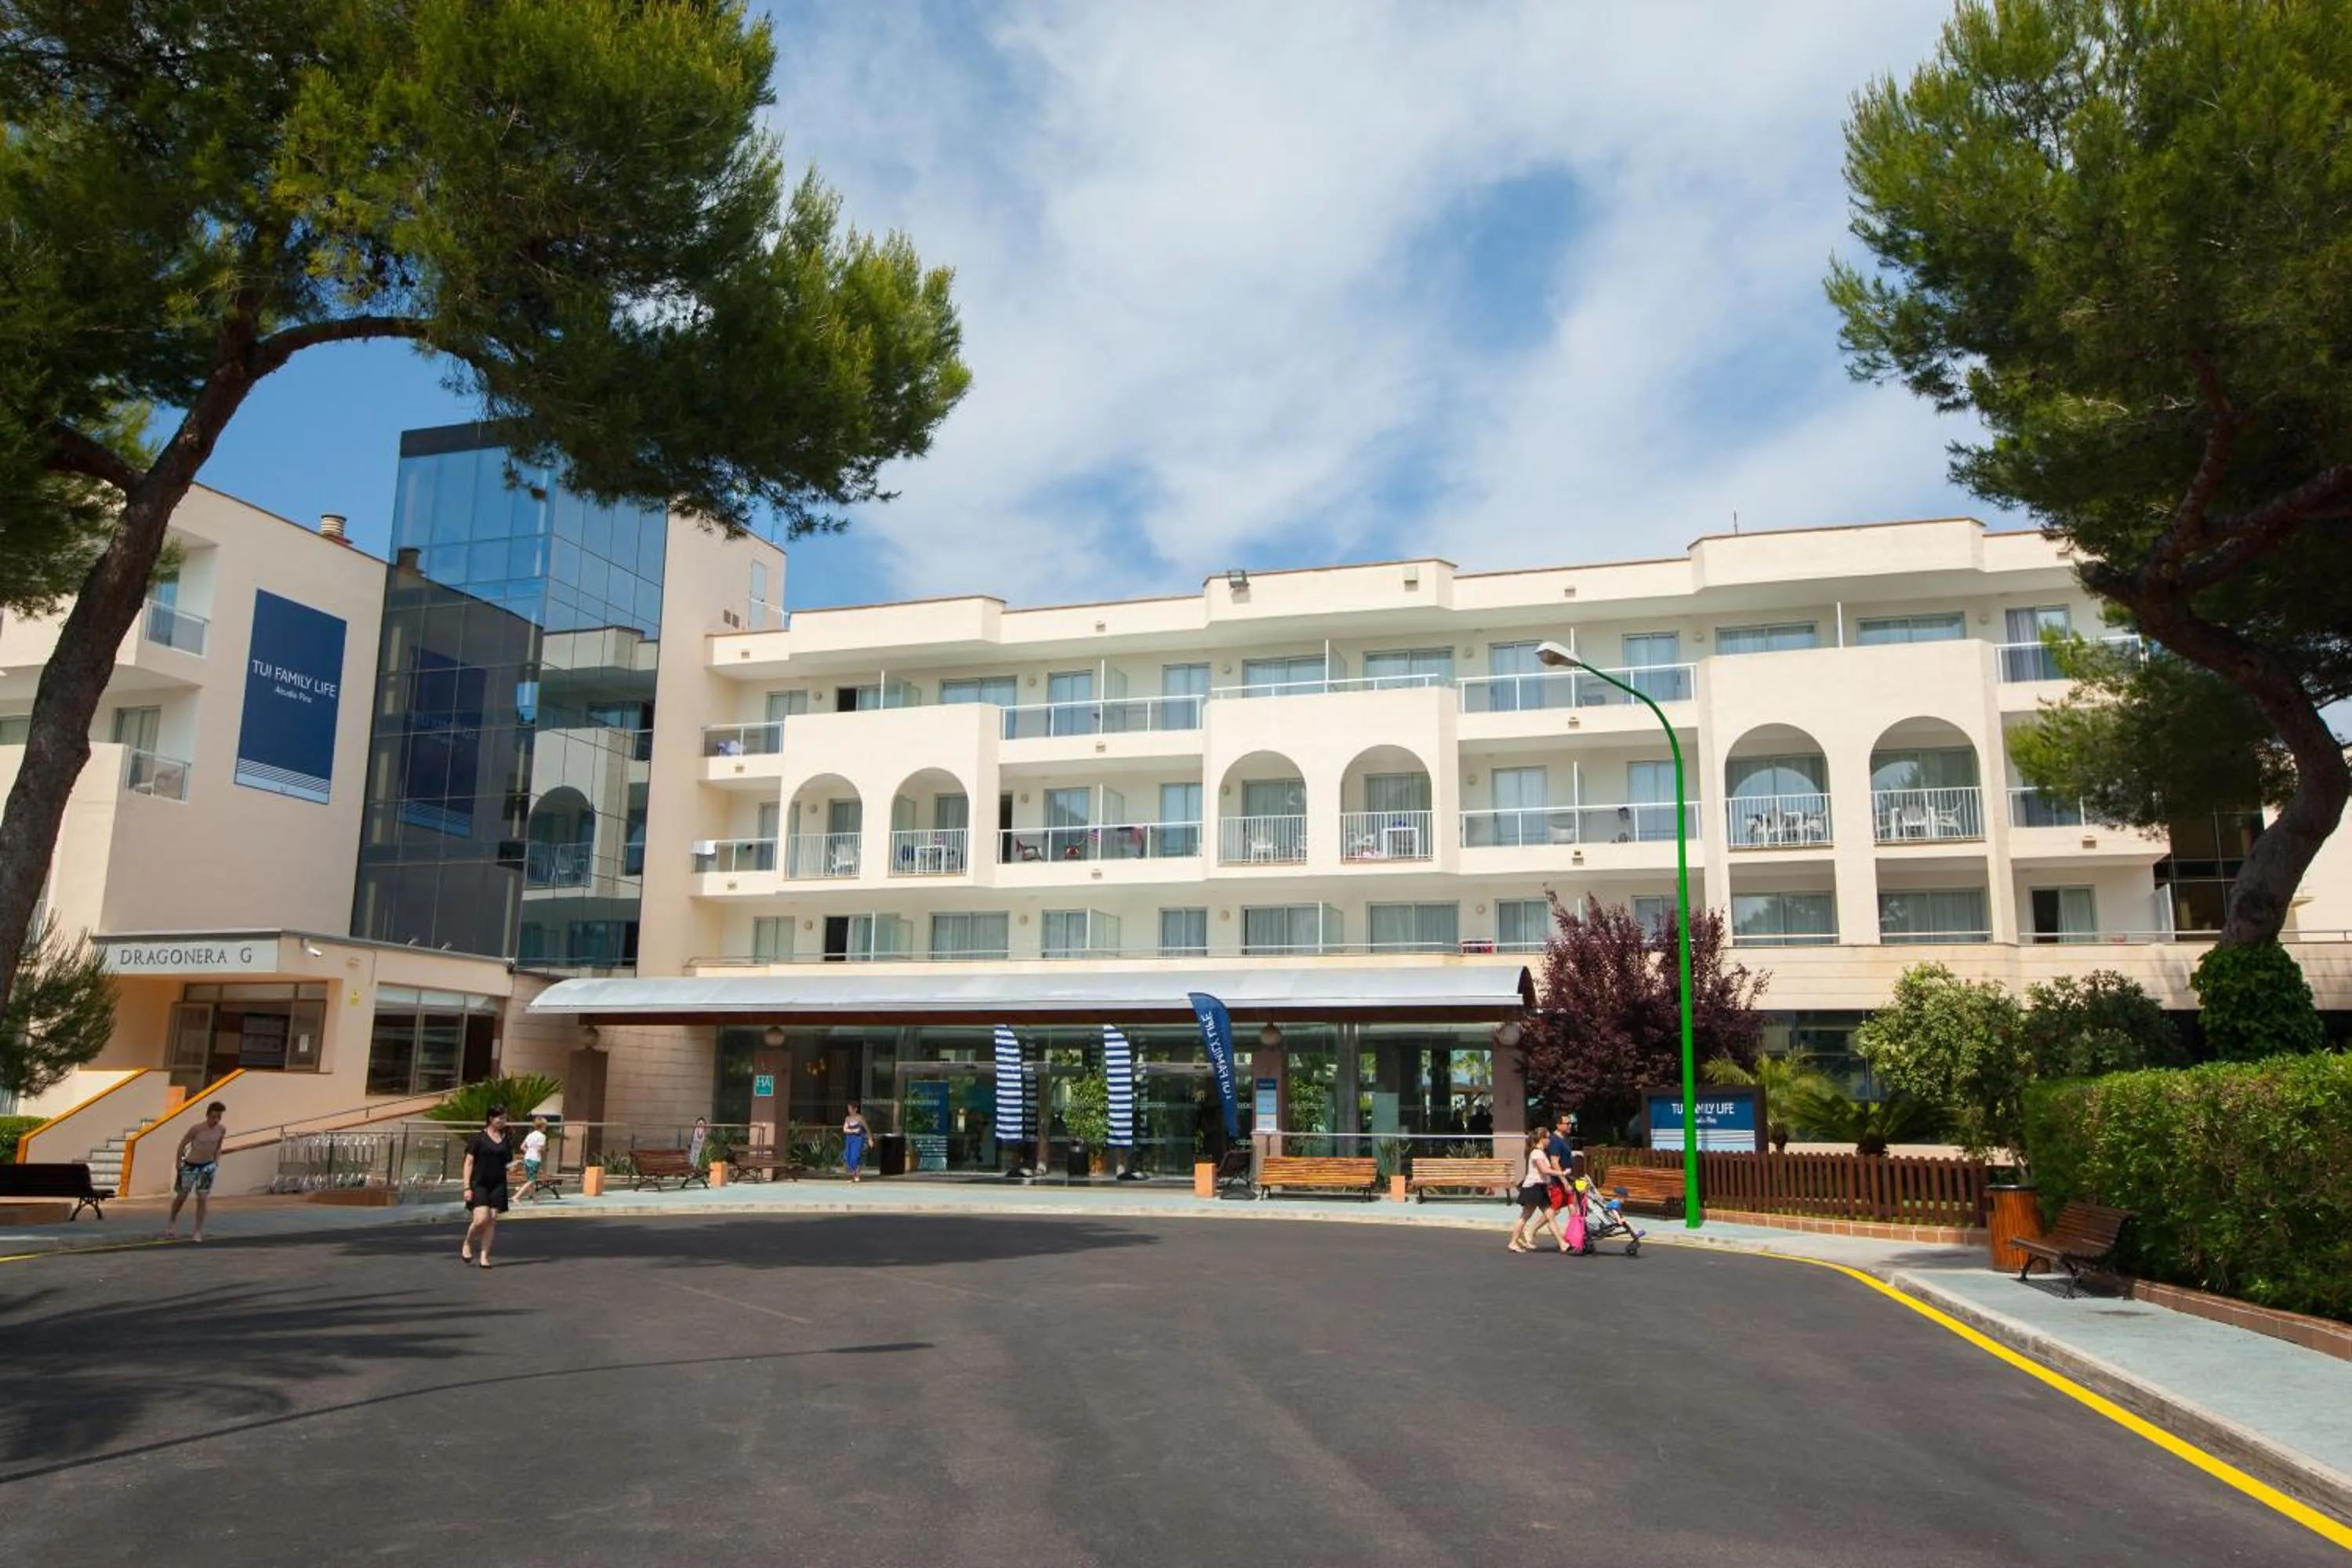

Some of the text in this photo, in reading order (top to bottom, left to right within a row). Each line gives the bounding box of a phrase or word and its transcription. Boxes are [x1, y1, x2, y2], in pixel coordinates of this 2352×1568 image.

[252, 659, 337, 698] TUI FAMILY LIFE
[120, 947, 252, 965] DRAGONERA G
[1671, 1103, 1683, 1114] TU
[1716, 1102, 1735, 1114] LIFE
